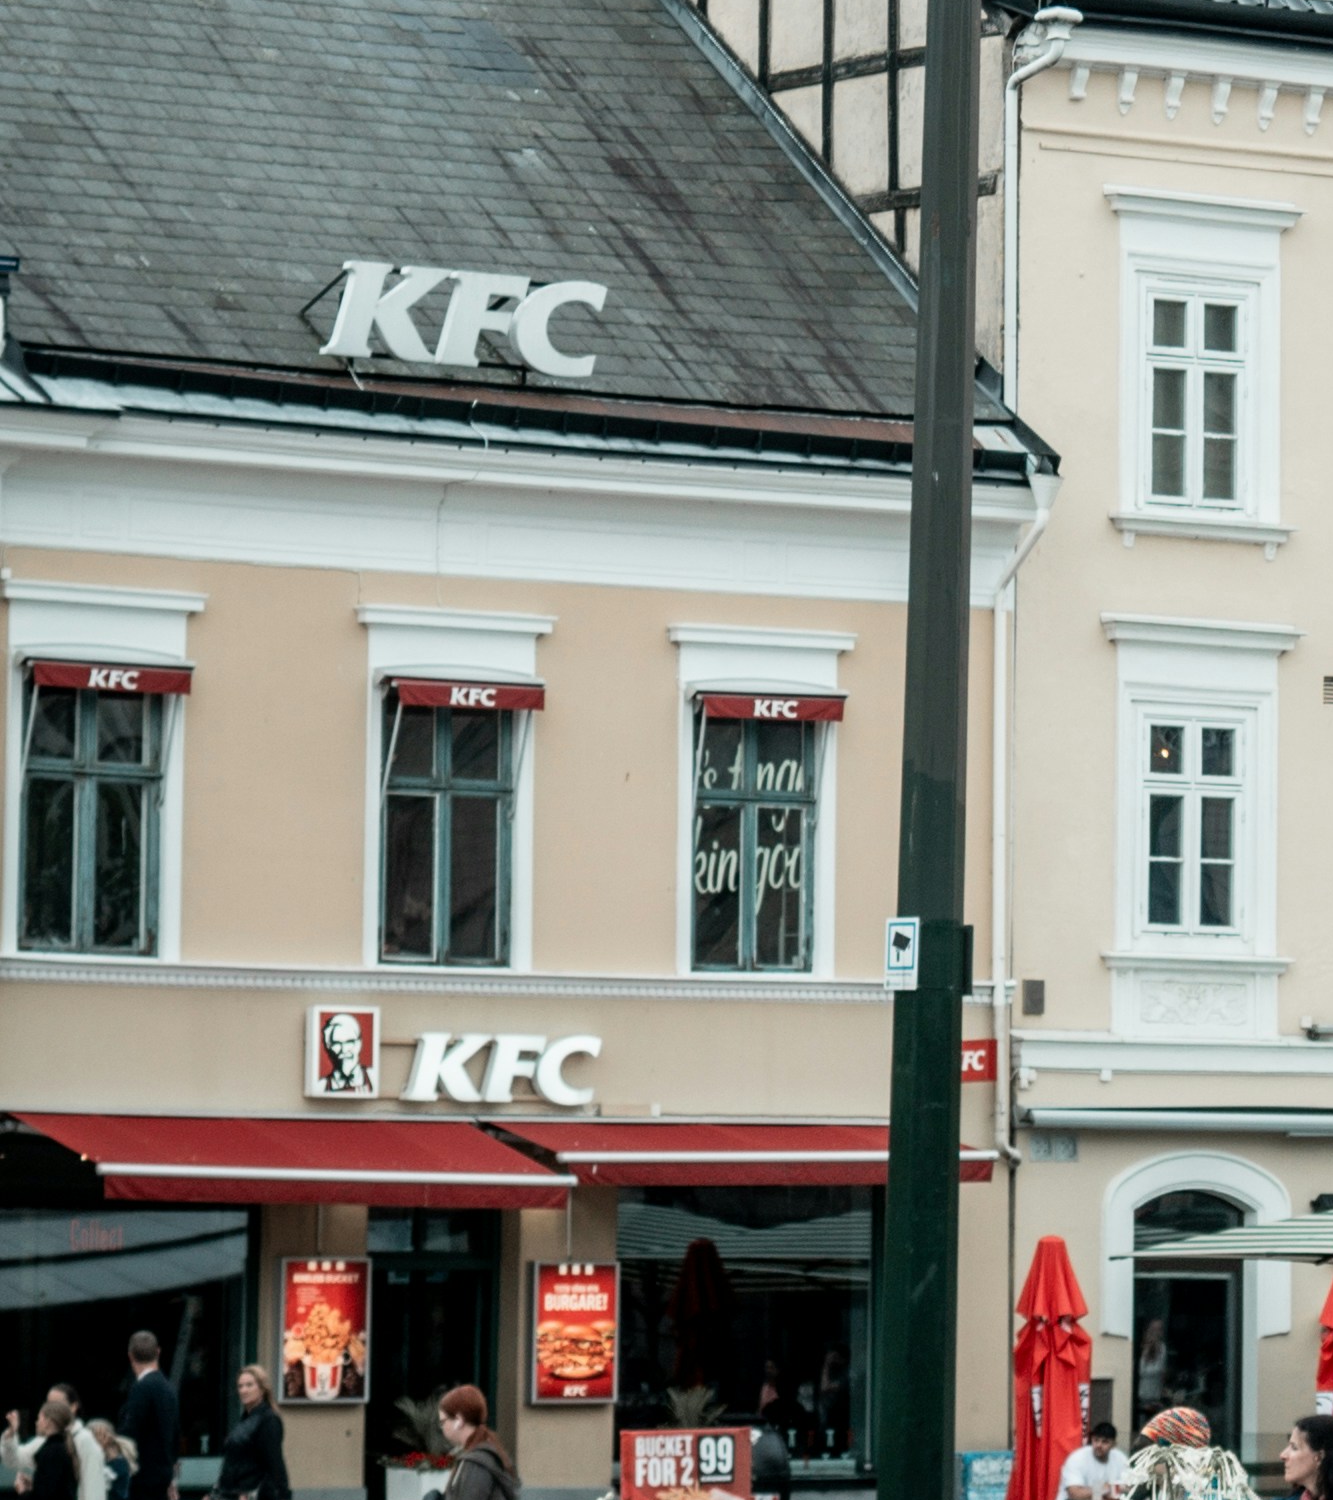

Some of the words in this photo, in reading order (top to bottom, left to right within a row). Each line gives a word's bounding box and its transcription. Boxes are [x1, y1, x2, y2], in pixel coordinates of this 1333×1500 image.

[319, 260, 608, 378] KFC
[87, 667, 141, 691] KFC
[449, 686, 497, 708] KFC
[753, 699, 800, 719] KFC
[401, 1031, 603, 1107] KFC
[961, 1049, 987, 1072] FC
[544, 1292, 609, 1312] BURGARE!
[634, 1434, 694, 1459] BUCKET
[699, 1436, 735, 1475] 99
[634, 1456, 678, 1488] FOR
[680, 1456, 695, 1487] 2
